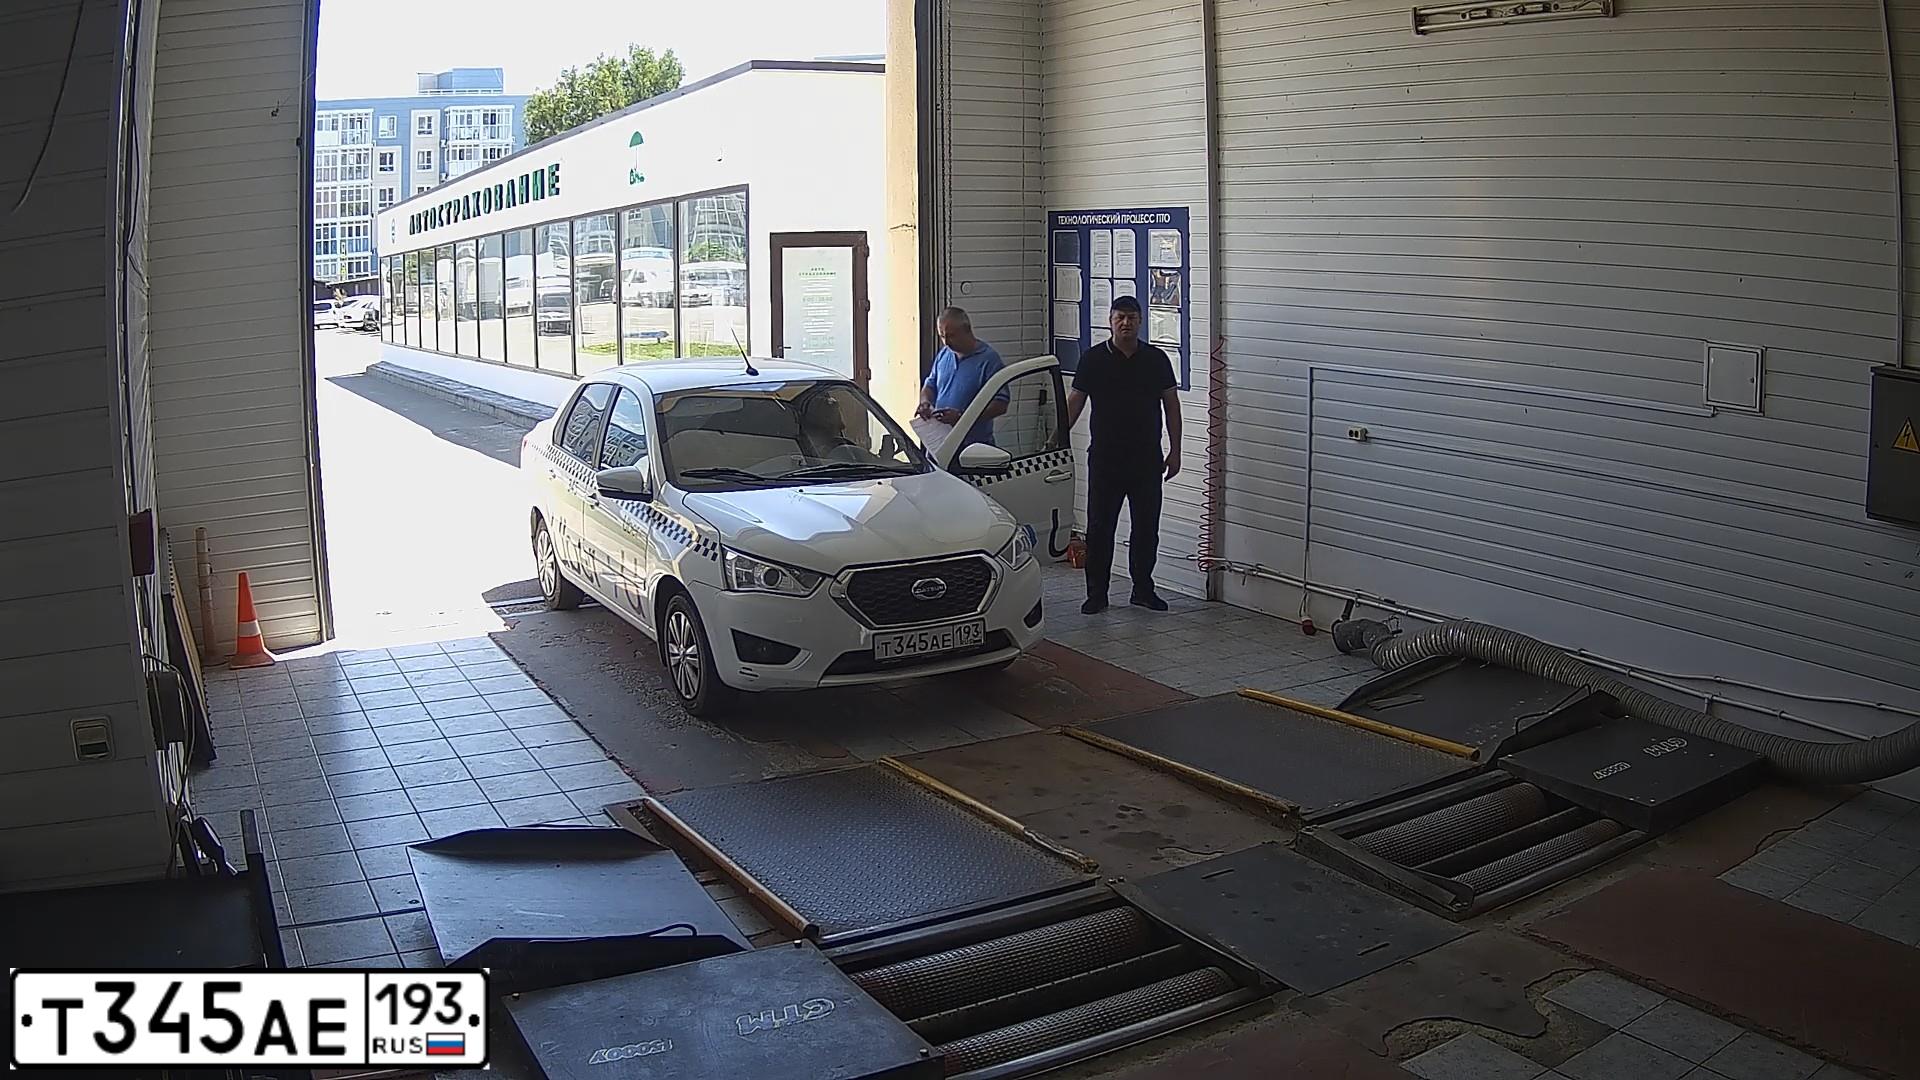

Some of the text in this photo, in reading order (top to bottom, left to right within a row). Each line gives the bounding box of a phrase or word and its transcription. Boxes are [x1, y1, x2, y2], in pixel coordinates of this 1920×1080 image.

[409, 163, 561, 236] АВТОСТРАХОВАНИЕ
[1058, 212, 1171, 225] ТЕХНОЛОГИЧЕСКИЙ ПРОЦЕСС ПТО
[881, 623, 980, 657] Т345АЕ 193
